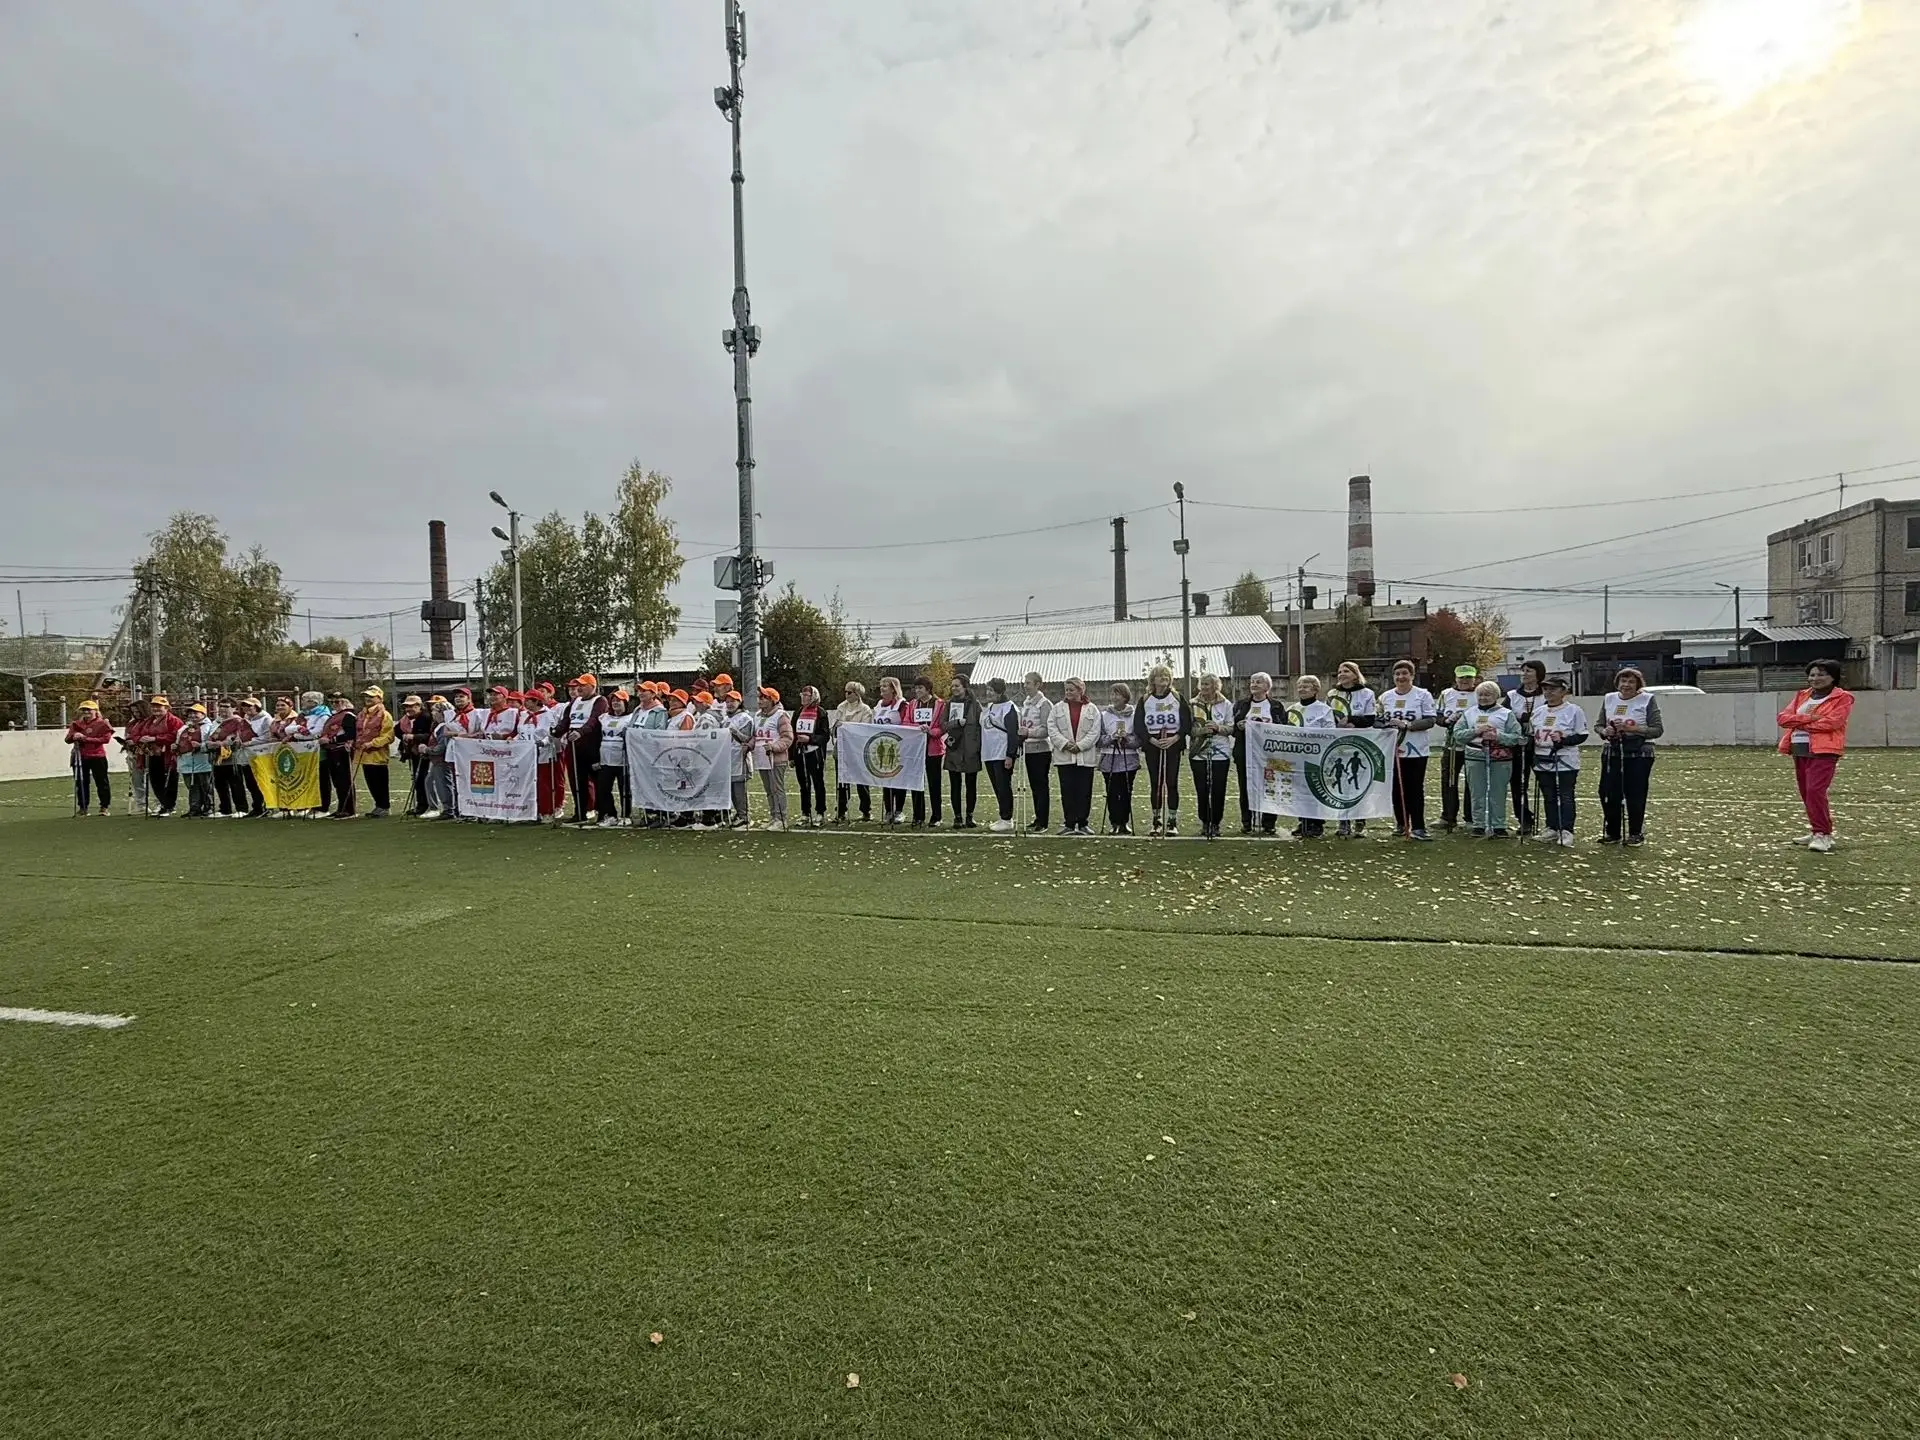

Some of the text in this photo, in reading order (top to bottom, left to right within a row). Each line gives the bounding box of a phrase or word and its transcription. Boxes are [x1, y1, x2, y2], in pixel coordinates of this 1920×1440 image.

[915, 710, 930, 720] 3.2
[1146, 713, 1176, 726] 388
[797, 720, 811, 731] 3.1
[1264, 739, 1320, 754] ДМИТРОВ
